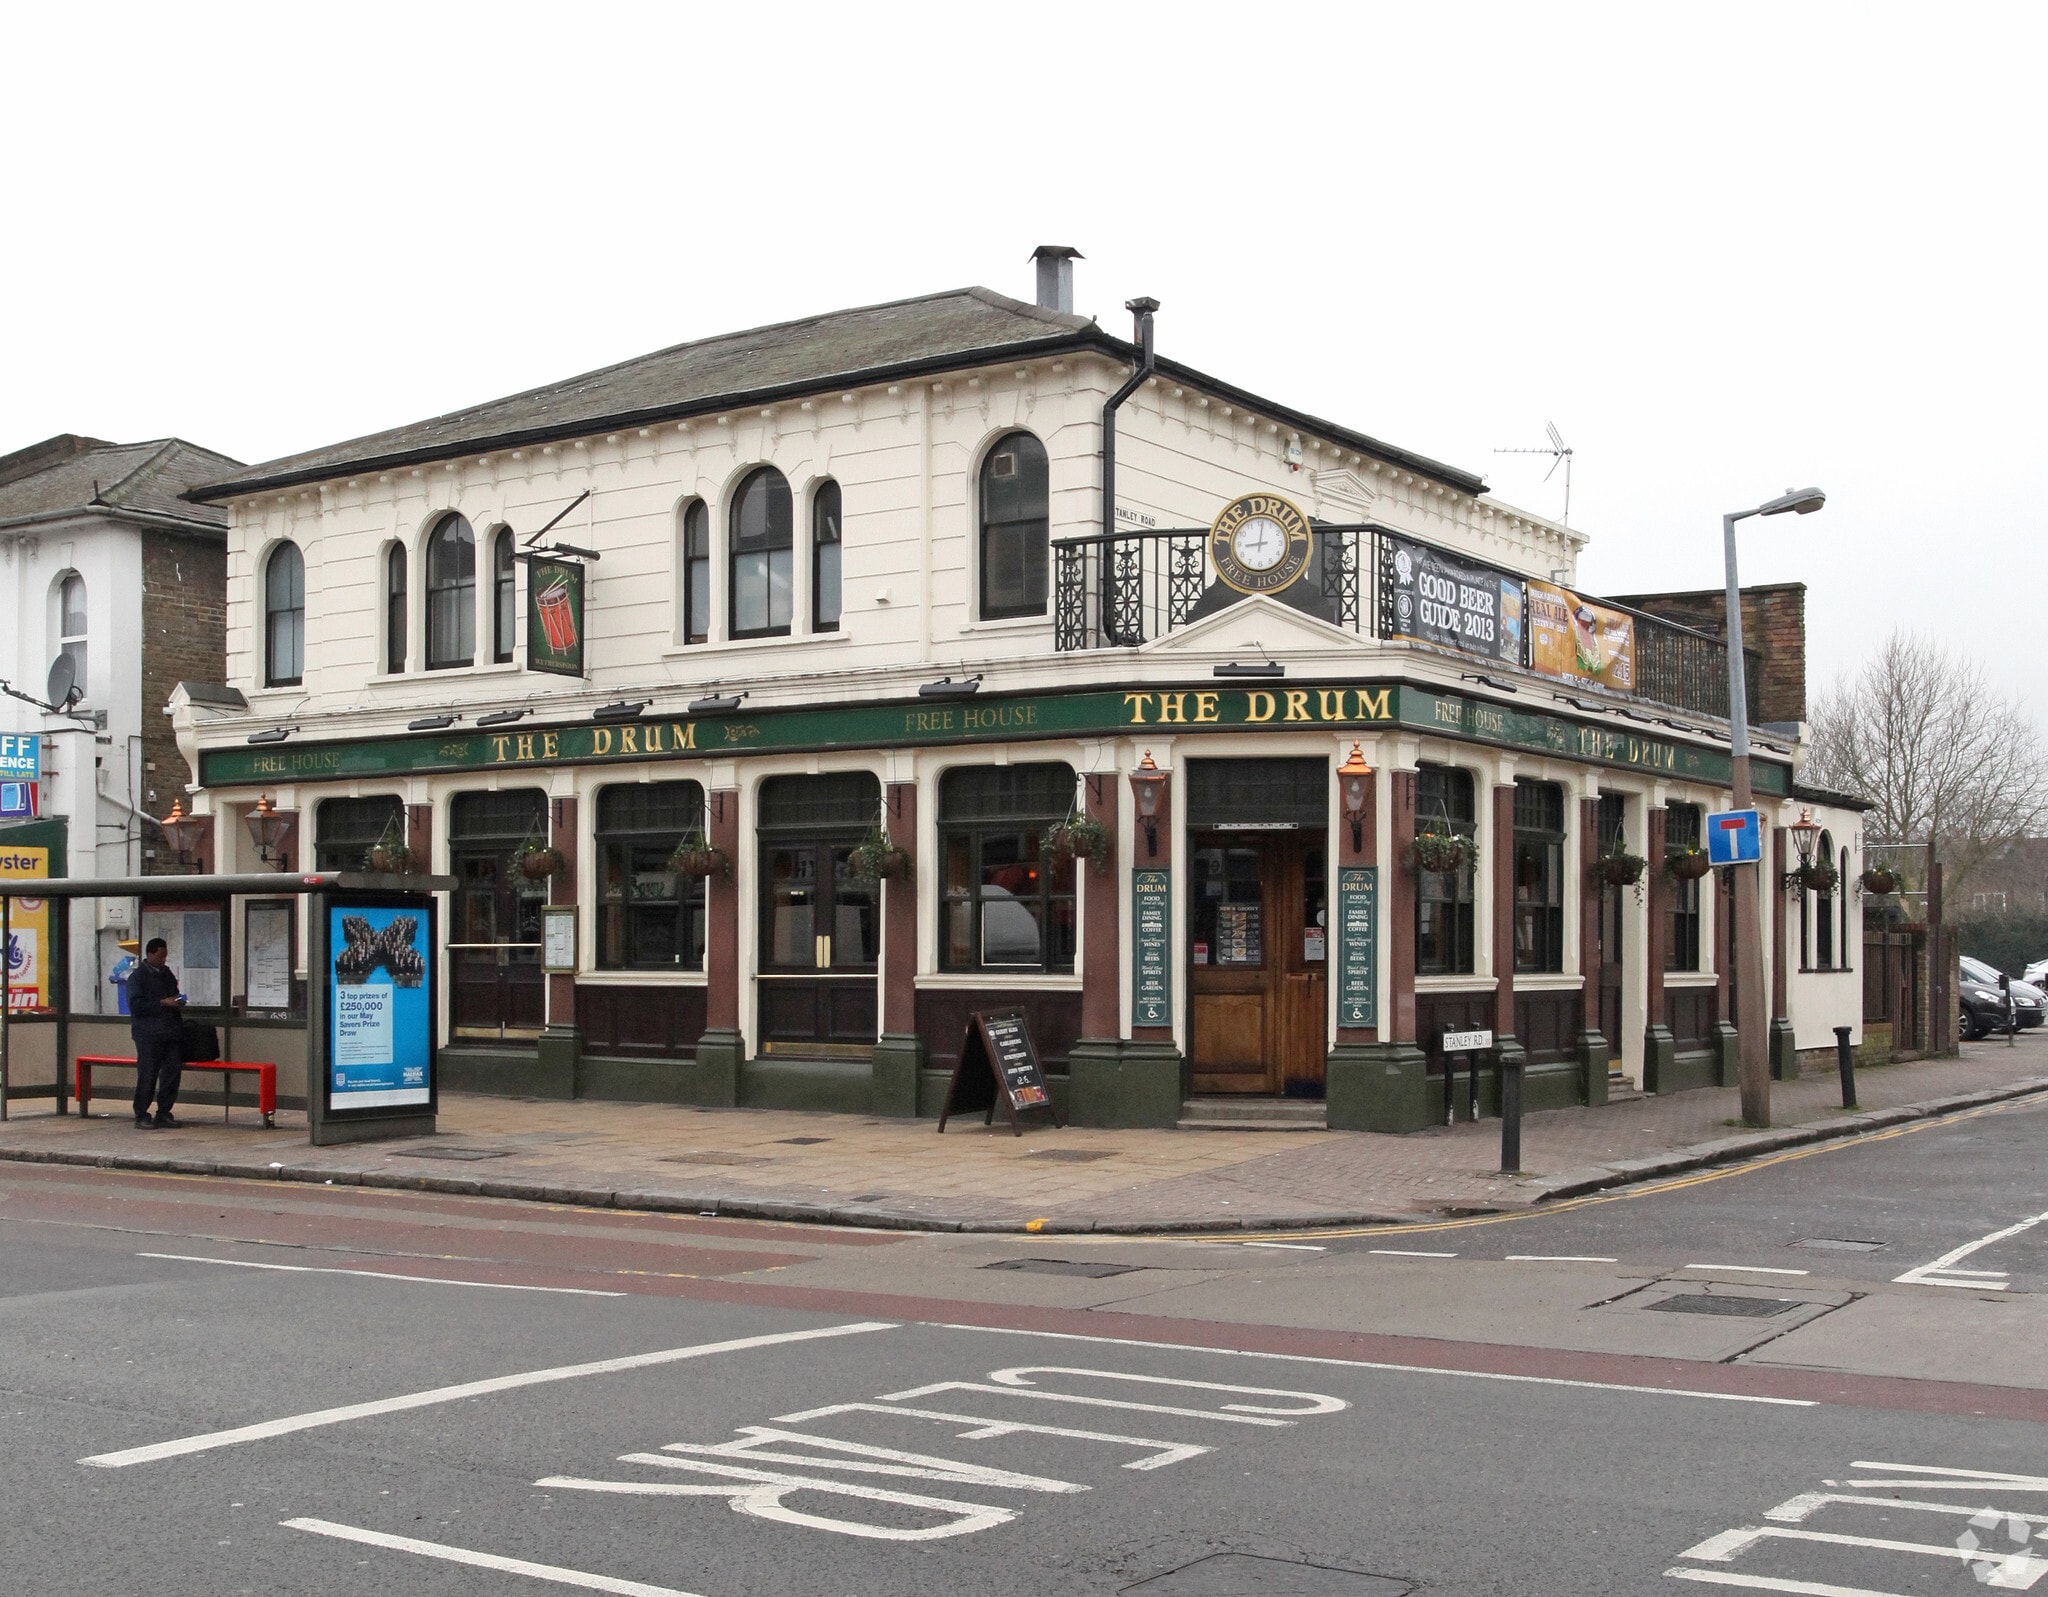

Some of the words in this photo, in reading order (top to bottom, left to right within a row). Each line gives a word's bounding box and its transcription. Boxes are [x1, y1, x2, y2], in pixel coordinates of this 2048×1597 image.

[1116, 508, 1137, 522] TANLEY
[1141, 515, 1156, 527] ROAD
[1214, 504, 1248, 545] THE
[1249, 497, 1307, 542] DRUM
[1221, 557, 1250, 585] FREE
[1257, 557, 1304, 587] HOUSE
[1419, 572, 1456, 605] GOOD
[1460, 585, 1495, 616] BEER
[1420, 599, 1461, 633] GUIDE
[1465, 613, 1495, 642] 2013
[906, 710, 954, 732] FREE
[964, 705, 1039, 728] HOUSE
[1124, 692, 1221, 724] THE
[1245, 689, 1393, 722] DRUM
[1435, 701, 1462, 725] FREE
[1467, 708, 1504, 732] HOUSE
[492, 731, 559, 763] THE
[592, 723, 697, 756] DRUM
[1577, 727, 1614, 759] THE
[1629, 738, 1675, 770] DRUM
[253, 756, 286, 773] FREE
[293, 752, 340, 770] HOUSE
[1137, 884, 1167, 893] DRUM
[1143, 875, 1158, 884] The
[1343, 883, 1373, 891] DRUM
[1349, 874, 1365, 882] The
[340, 991, 346, 1000] 3
[360, 992, 380, 1000] prizes
[341, 1002, 383, 1012] £250,000
[1445, 1036, 1472, 1049] STANLEY
[1474, 1035, 1483, 1046] RD
[533, 1366, 1353, 1541] CLEAR
